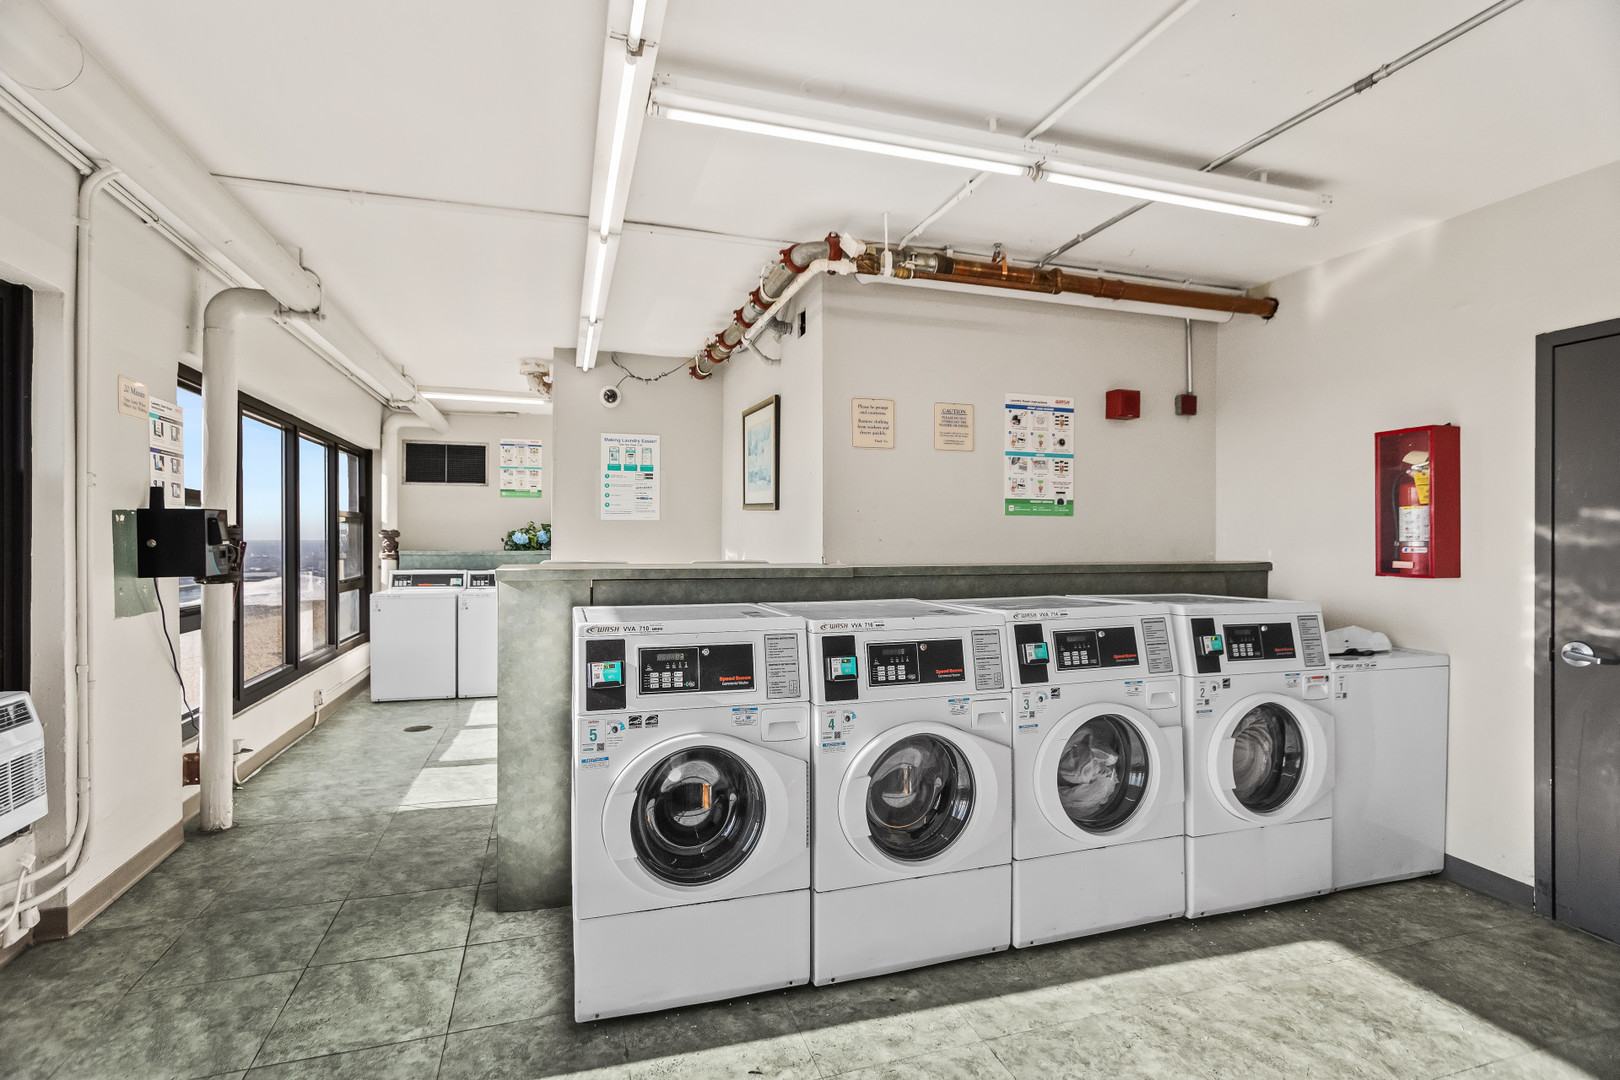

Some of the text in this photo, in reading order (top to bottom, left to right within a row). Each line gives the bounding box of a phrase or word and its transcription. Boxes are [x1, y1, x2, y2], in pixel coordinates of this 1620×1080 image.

[1200, 688, 1205, 698] 2
[1024, 699, 1030, 710] 3
[828, 718, 835, 730] 4
[590, 728, 598, 742] 5
